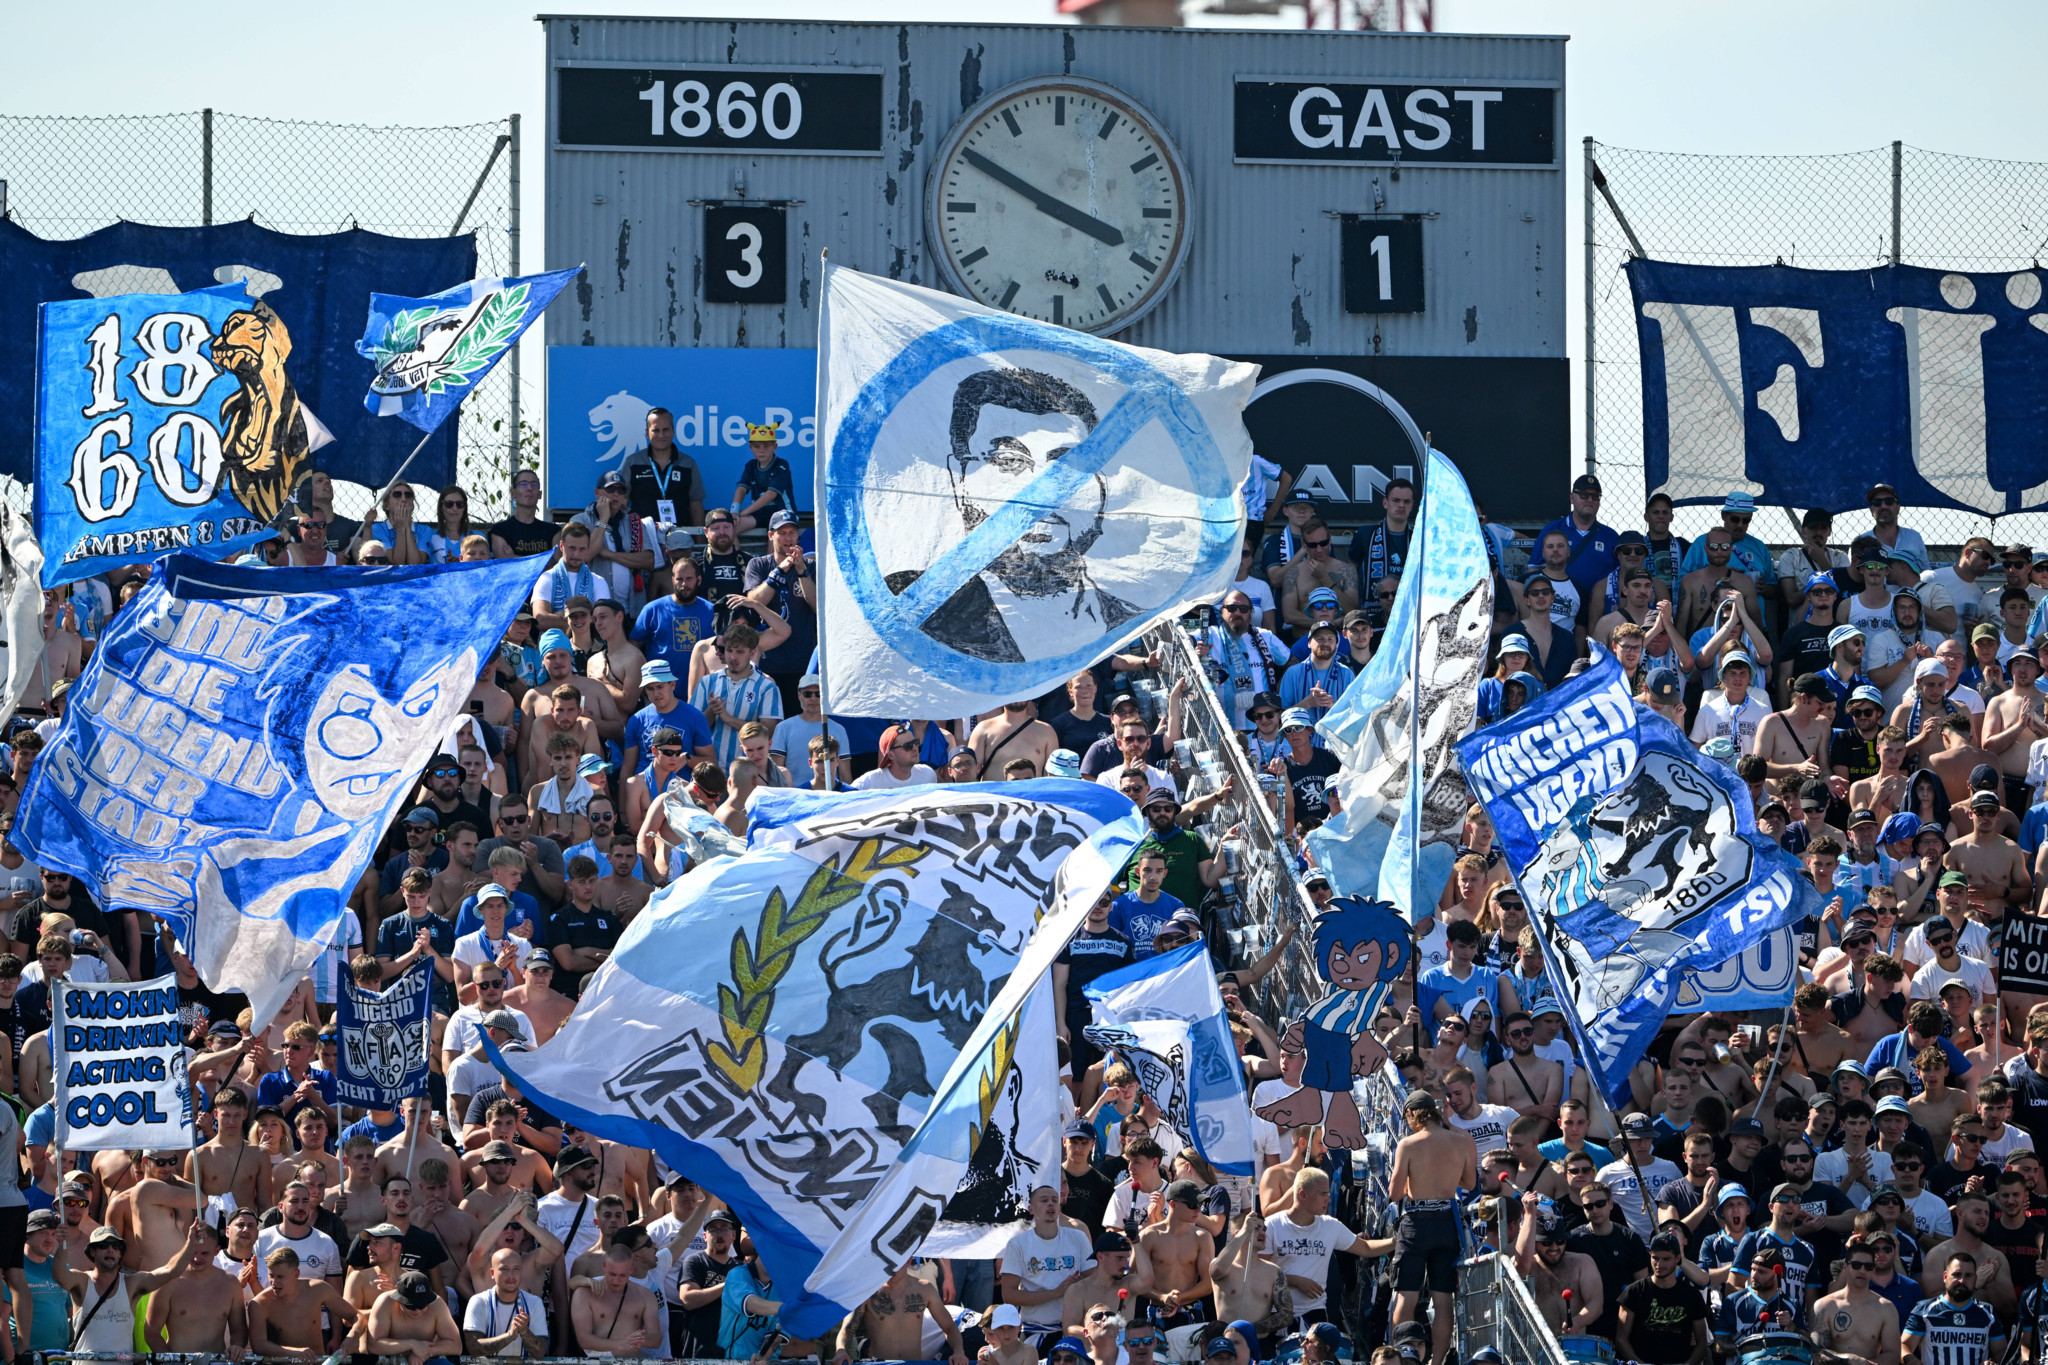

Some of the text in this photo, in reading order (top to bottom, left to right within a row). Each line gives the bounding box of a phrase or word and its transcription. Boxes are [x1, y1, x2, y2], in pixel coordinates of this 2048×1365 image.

[639, 79, 802, 140] 1860
[1289, 87, 1503, 151] GAST
[725, 221, 764, 289] 3
[1370, 235, 1393, 301] 1
[83, 311, 224, 419] 18
[676, 405, 749, 447] die
[66, 410, 225, 524] 60
[1266, 464, 1414, 504] AN
[140, 594, 278, 674] SIND
[139, 648, 240, 724] DIE
[83, 668, 284, 798] JUGEND
[90, 728, 207, 816] DER
[46, 747, 222, 847] STADT
[1663, 870, 1728, 917] 1860
[1723, 869, 1794, 935] TSV
[1072, 941, 1096, 953] Boys
[2004, 945, 2018, 970] IS
[354, 997, 415, 1023] JUGEND
[66, 1056, 166, 1087] ACTING
[337, 1080, 376, 1102] STEHT
[373, 1063, 402, 1085] 1860
[66, 1091, 167, 1129] COOL
[1467, 1121, 1502, 1138] SDALE
[1282, 1240, 1293, 1248] 18
[1930, 1330, 1987, 1346] MÜNCHEN
